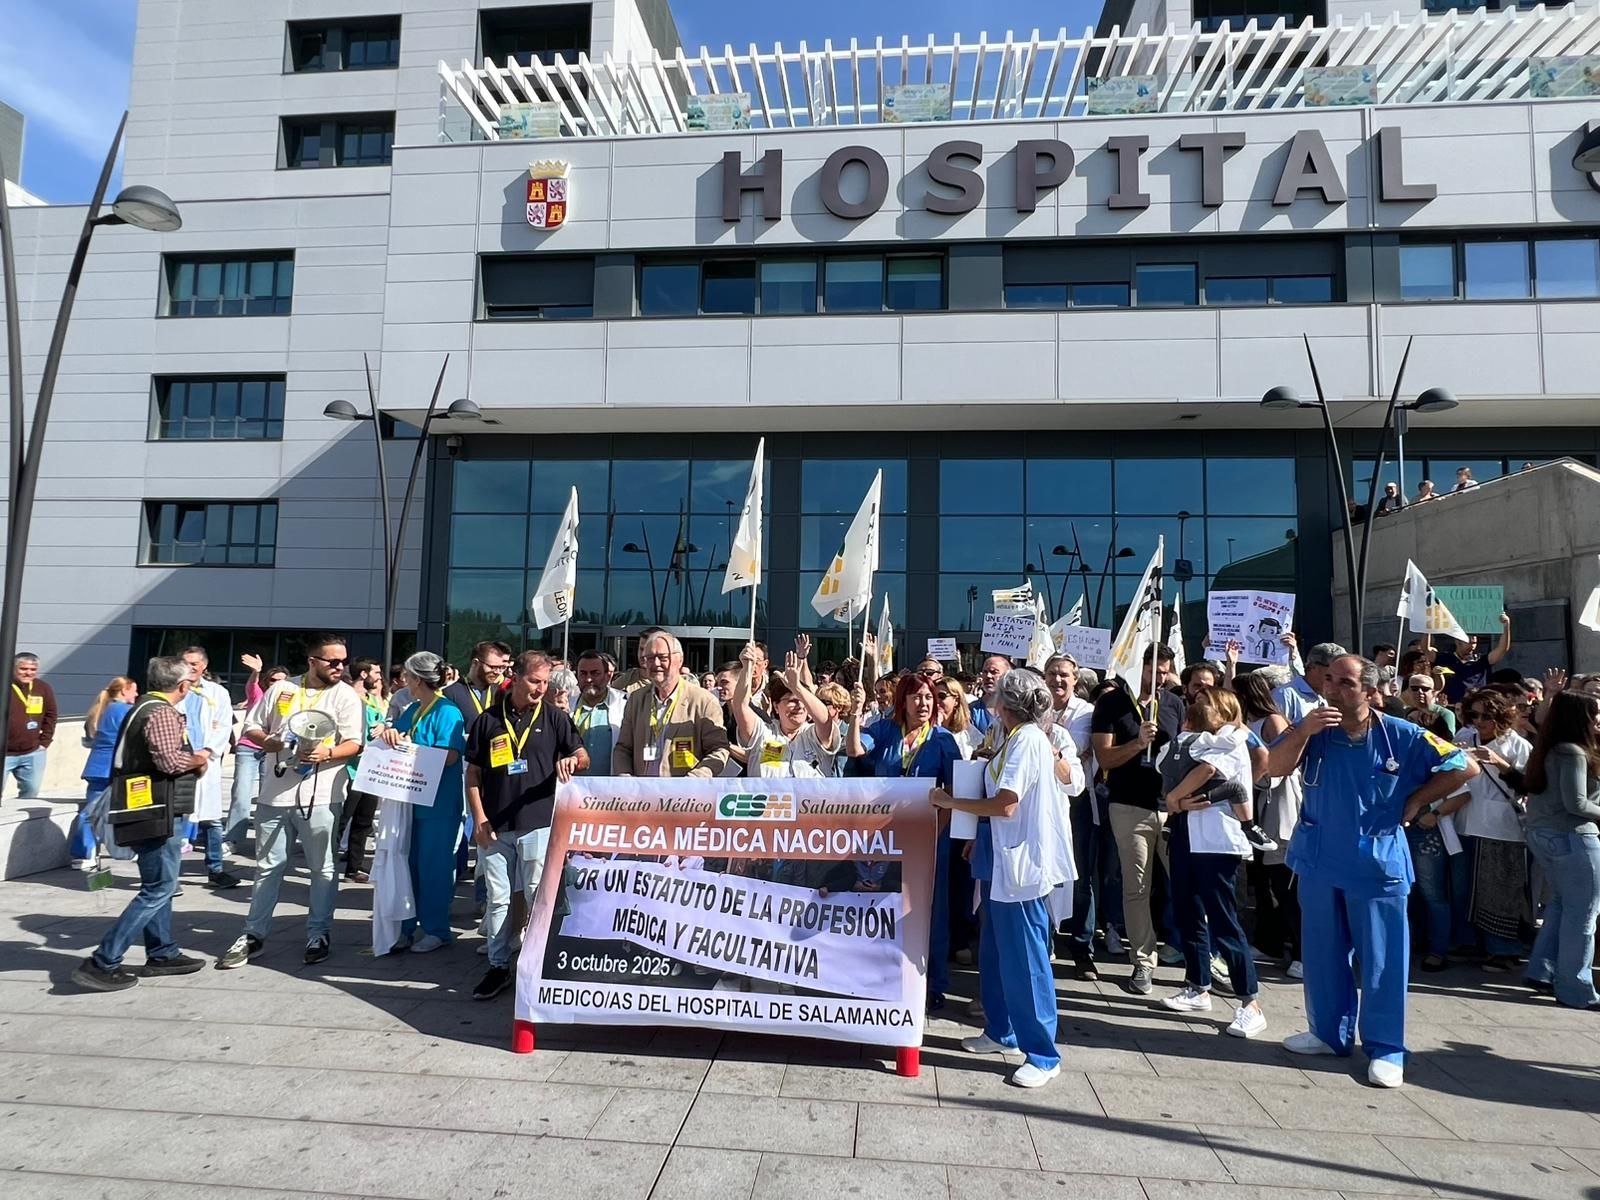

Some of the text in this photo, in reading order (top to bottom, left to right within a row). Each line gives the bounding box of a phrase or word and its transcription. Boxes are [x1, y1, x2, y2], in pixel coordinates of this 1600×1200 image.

[723, 127, 1437, 222] HOSPITAL
[579, 794, 892, 818] Sindicato Médico CESM Salamanca
[568, 822, 903, 855] HUELGA MÉDICA NACIONAL
[574, 867, 896, 940] OR UN ESTATUTO DE LA PROFESIÓN
[612, 904, 819, 979] MÉDICA Y FACULTATIVA
[557, 951, 671, 976] 3 octubre 2025
[538, 986, 914, 1027] MEDICO/AS DEL HOSPITAL DE SALAMANCA
